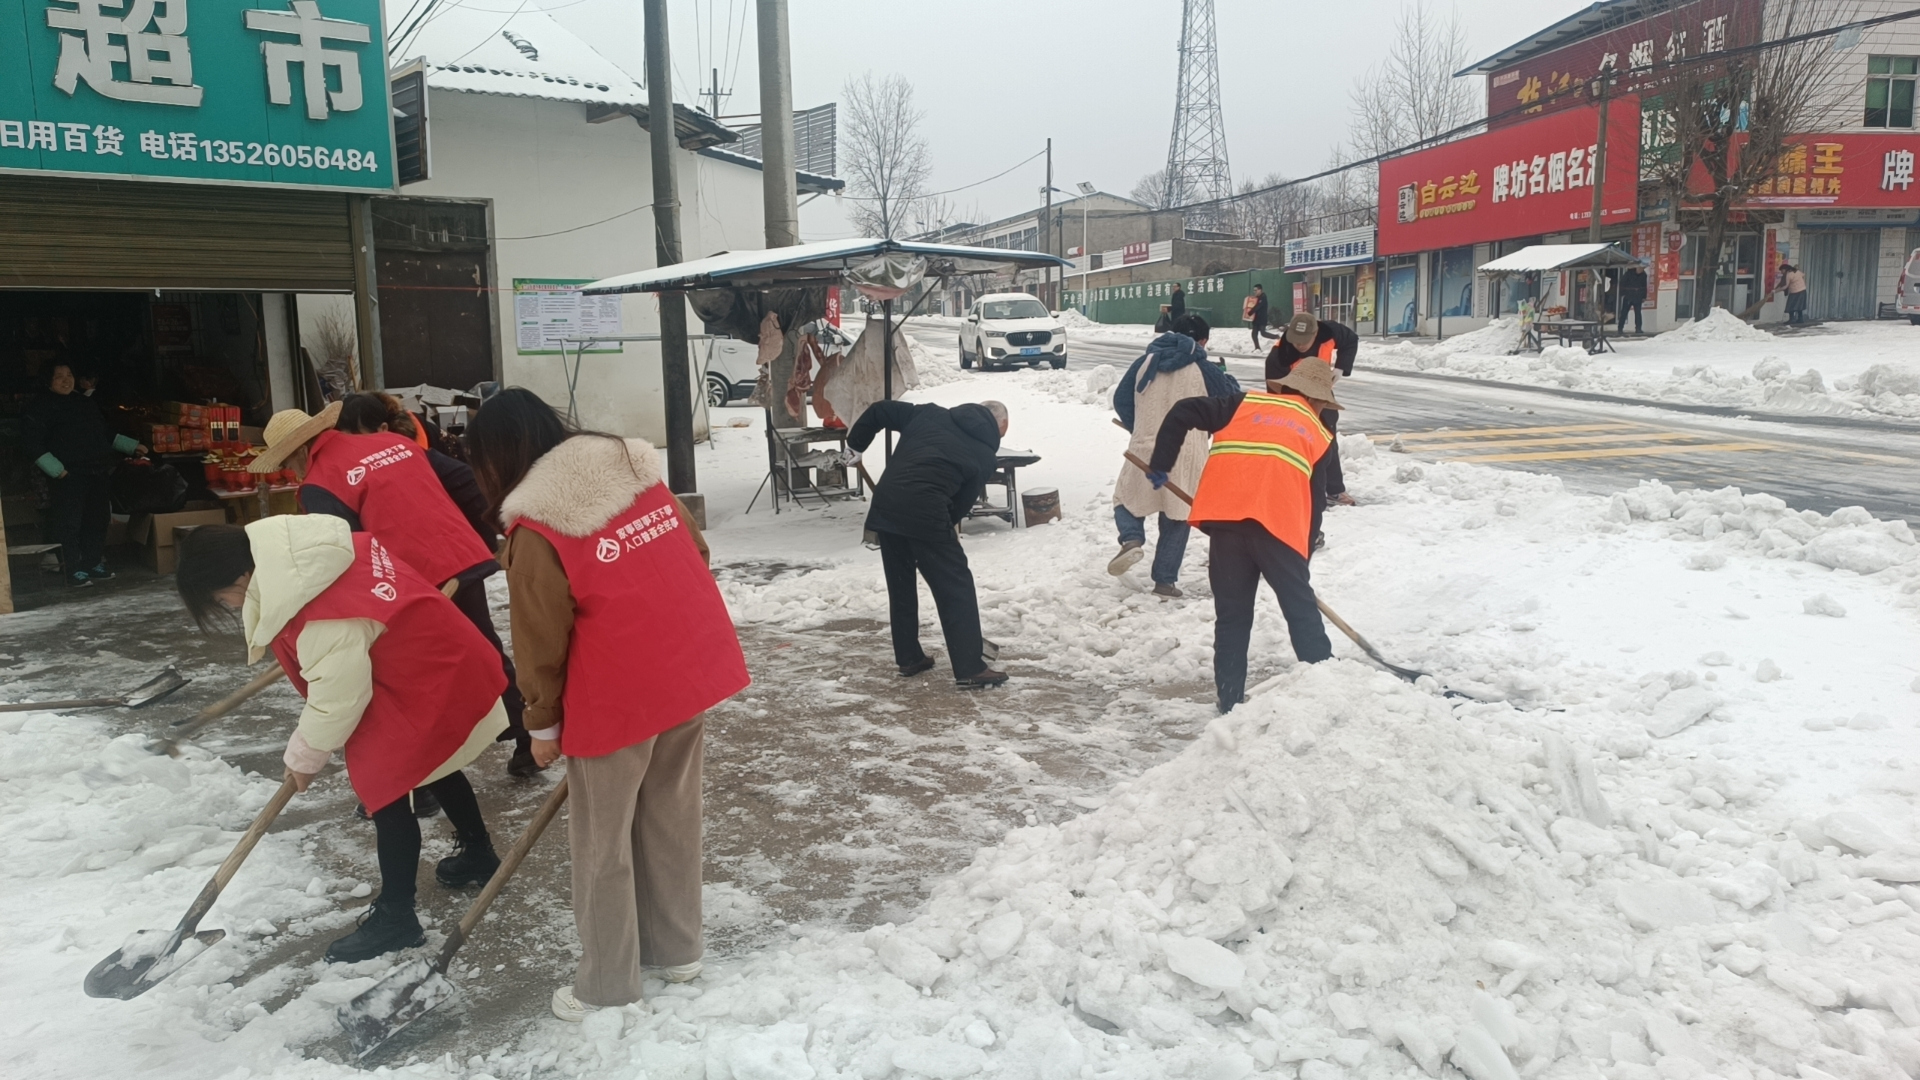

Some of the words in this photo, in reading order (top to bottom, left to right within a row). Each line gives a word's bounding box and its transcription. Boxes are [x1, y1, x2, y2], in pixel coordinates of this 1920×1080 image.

[45, 0, 371, 120] 超市
[0, 120, 125, 157] 日用百货
[140, 130, 378, 173] 电话13526056484
[1420, 169, 1481, 206] 白云边
[1881, 149, 1914, 191] 牌
[1114, 285, 1142, 300] 乡风文明
[1147, 283, 1171, 297] 治理有
[1187, 278, 1224, 295] 生活富裕
[615, 504, 673, 540] 家事国事天下事
[625, 516, 679, 553] 人口普查全民事
